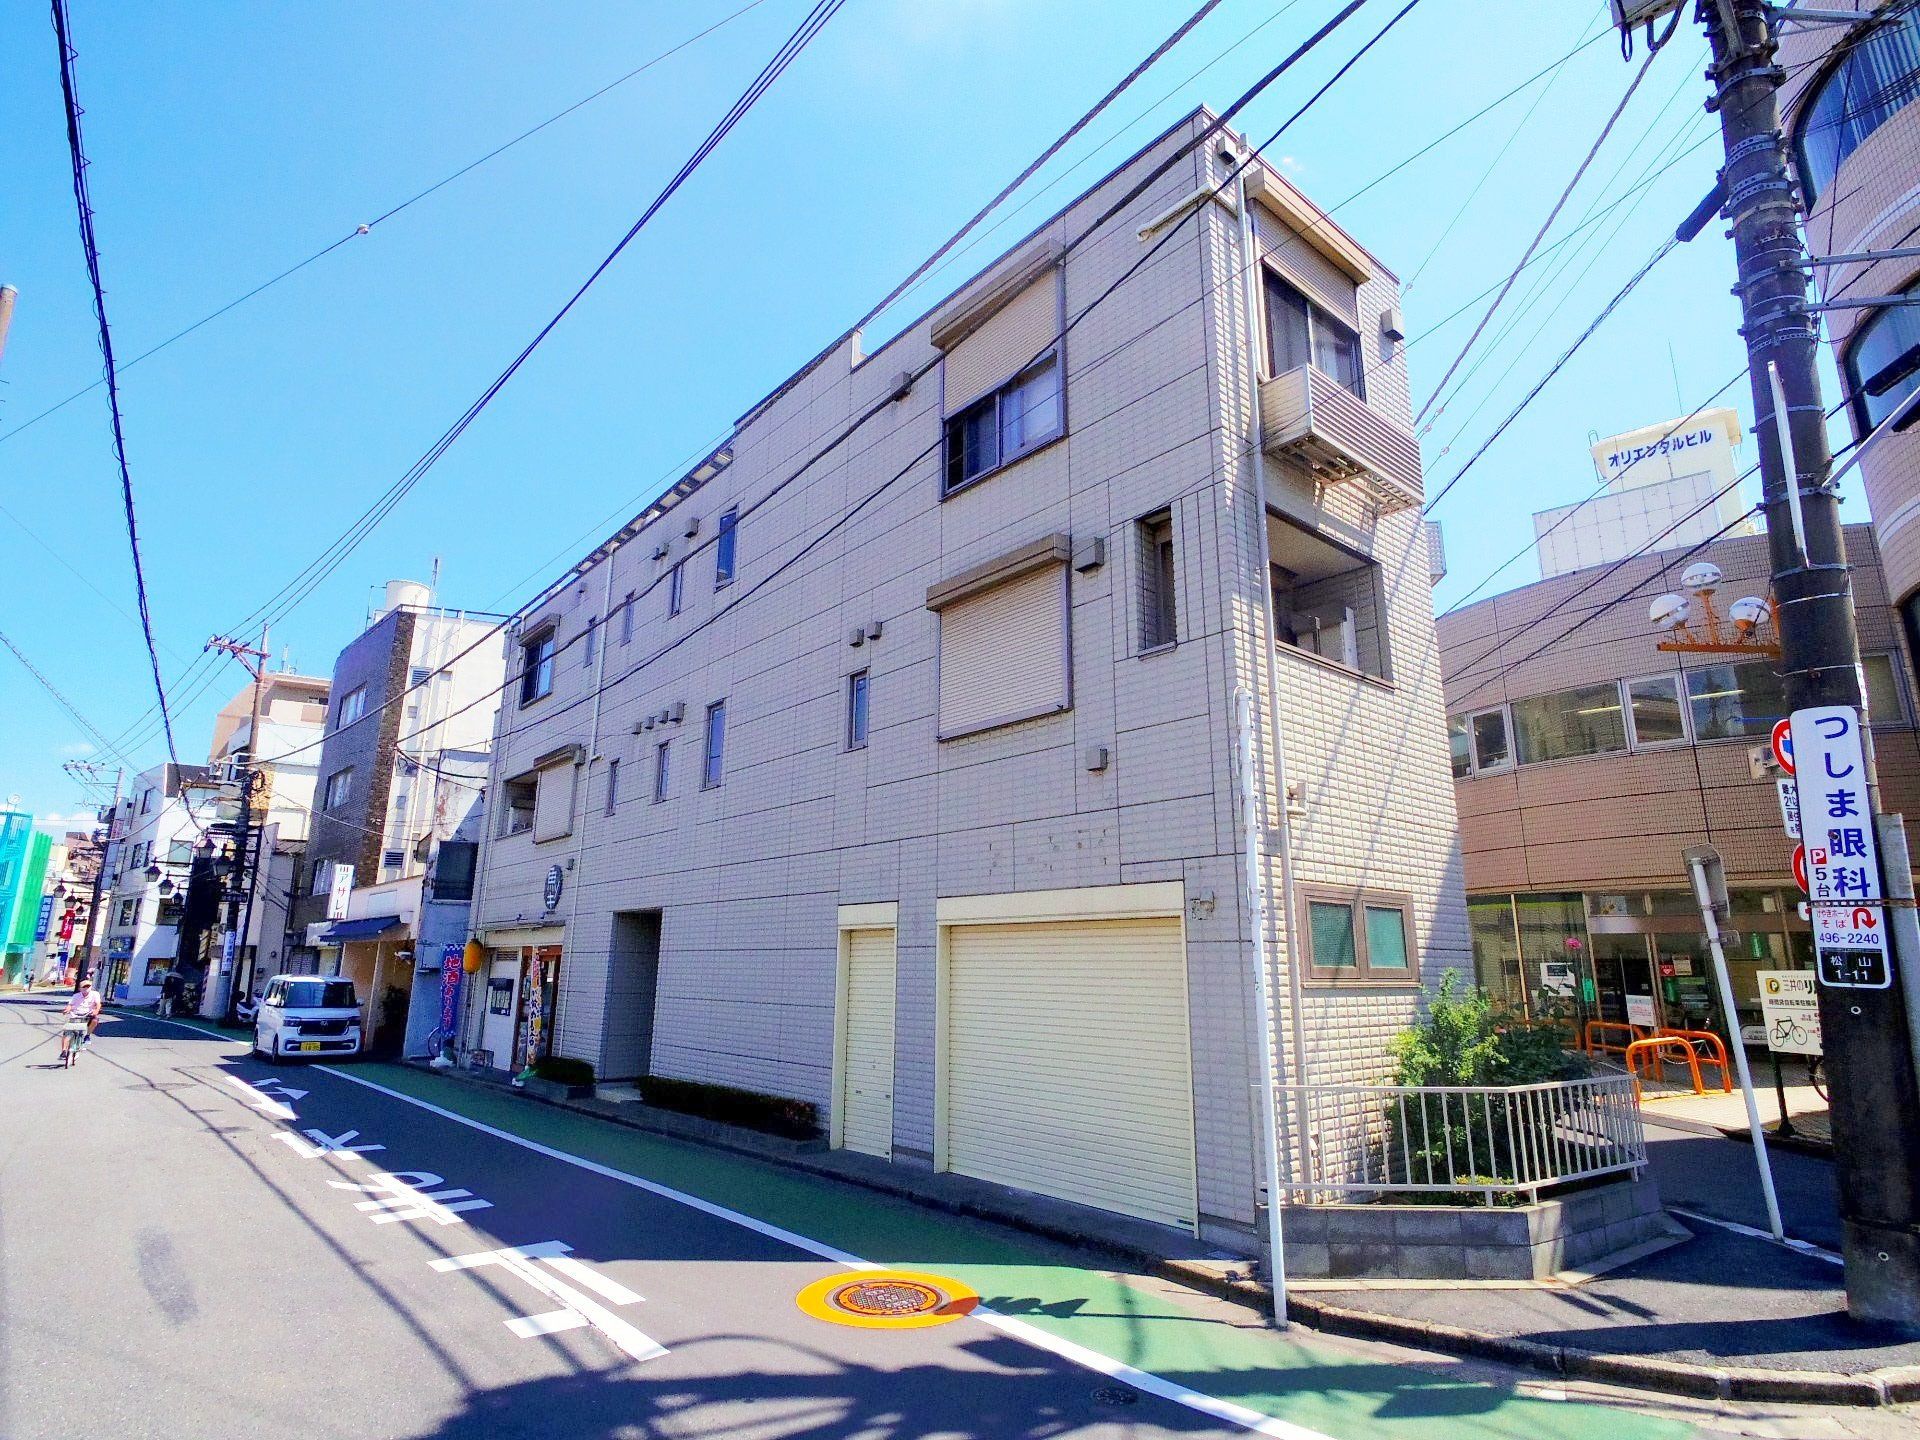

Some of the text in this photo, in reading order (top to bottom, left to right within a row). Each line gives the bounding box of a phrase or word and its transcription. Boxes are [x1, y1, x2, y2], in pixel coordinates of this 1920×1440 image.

[1608, 429, 1712, 467] オリエンタルビル
[1814, 716, 1871, 897] つしま眼科
[1819, 932, 1879, 945] 496-2240
[1829, 955, 1872, 967] 松山
[1835, 969, 1868, 981] 1-11
[443, 953, 462, 1030] 地酒あります
